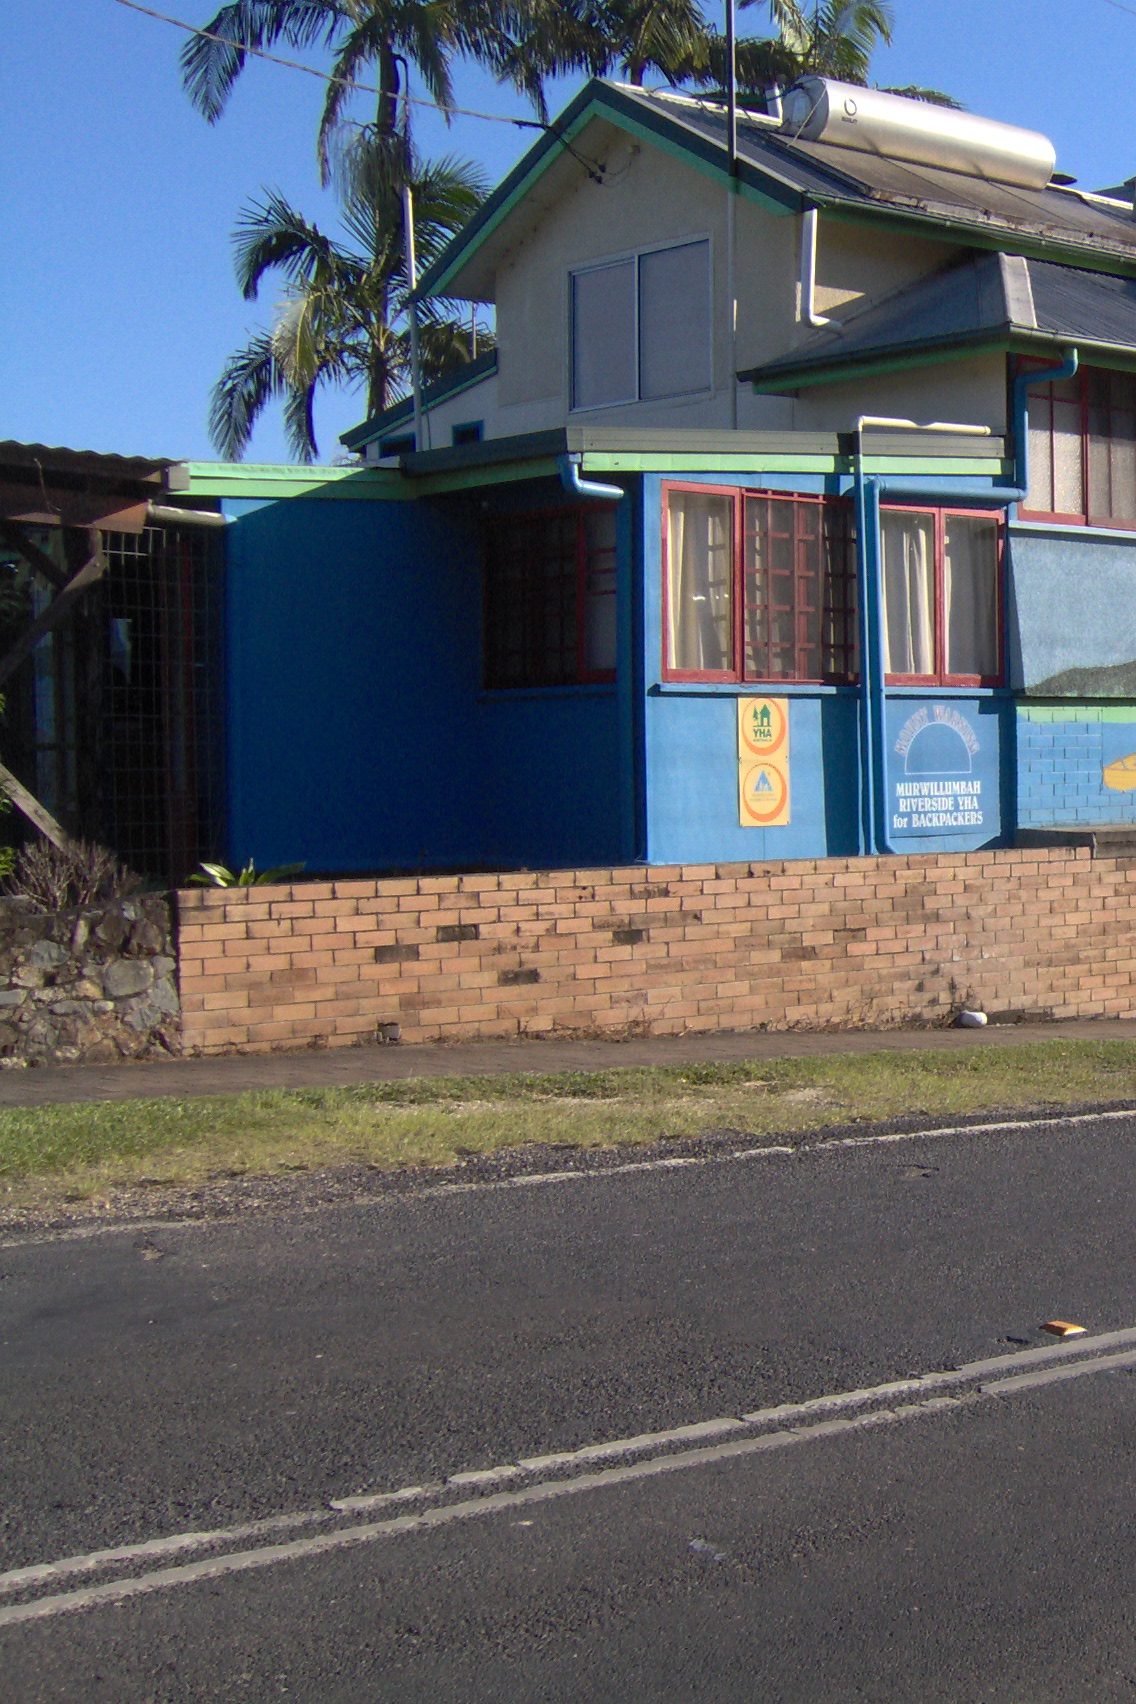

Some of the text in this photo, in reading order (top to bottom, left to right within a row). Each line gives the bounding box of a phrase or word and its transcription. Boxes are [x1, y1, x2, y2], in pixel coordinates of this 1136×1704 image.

[752, 728, 772, 738] YHA
[895, 780, 981, 797] MURWILLUMBAH
[899, 796, 979, 812] RIVERSIDE YHA
[893, 811, 984, 829] for BACKPACKERS
